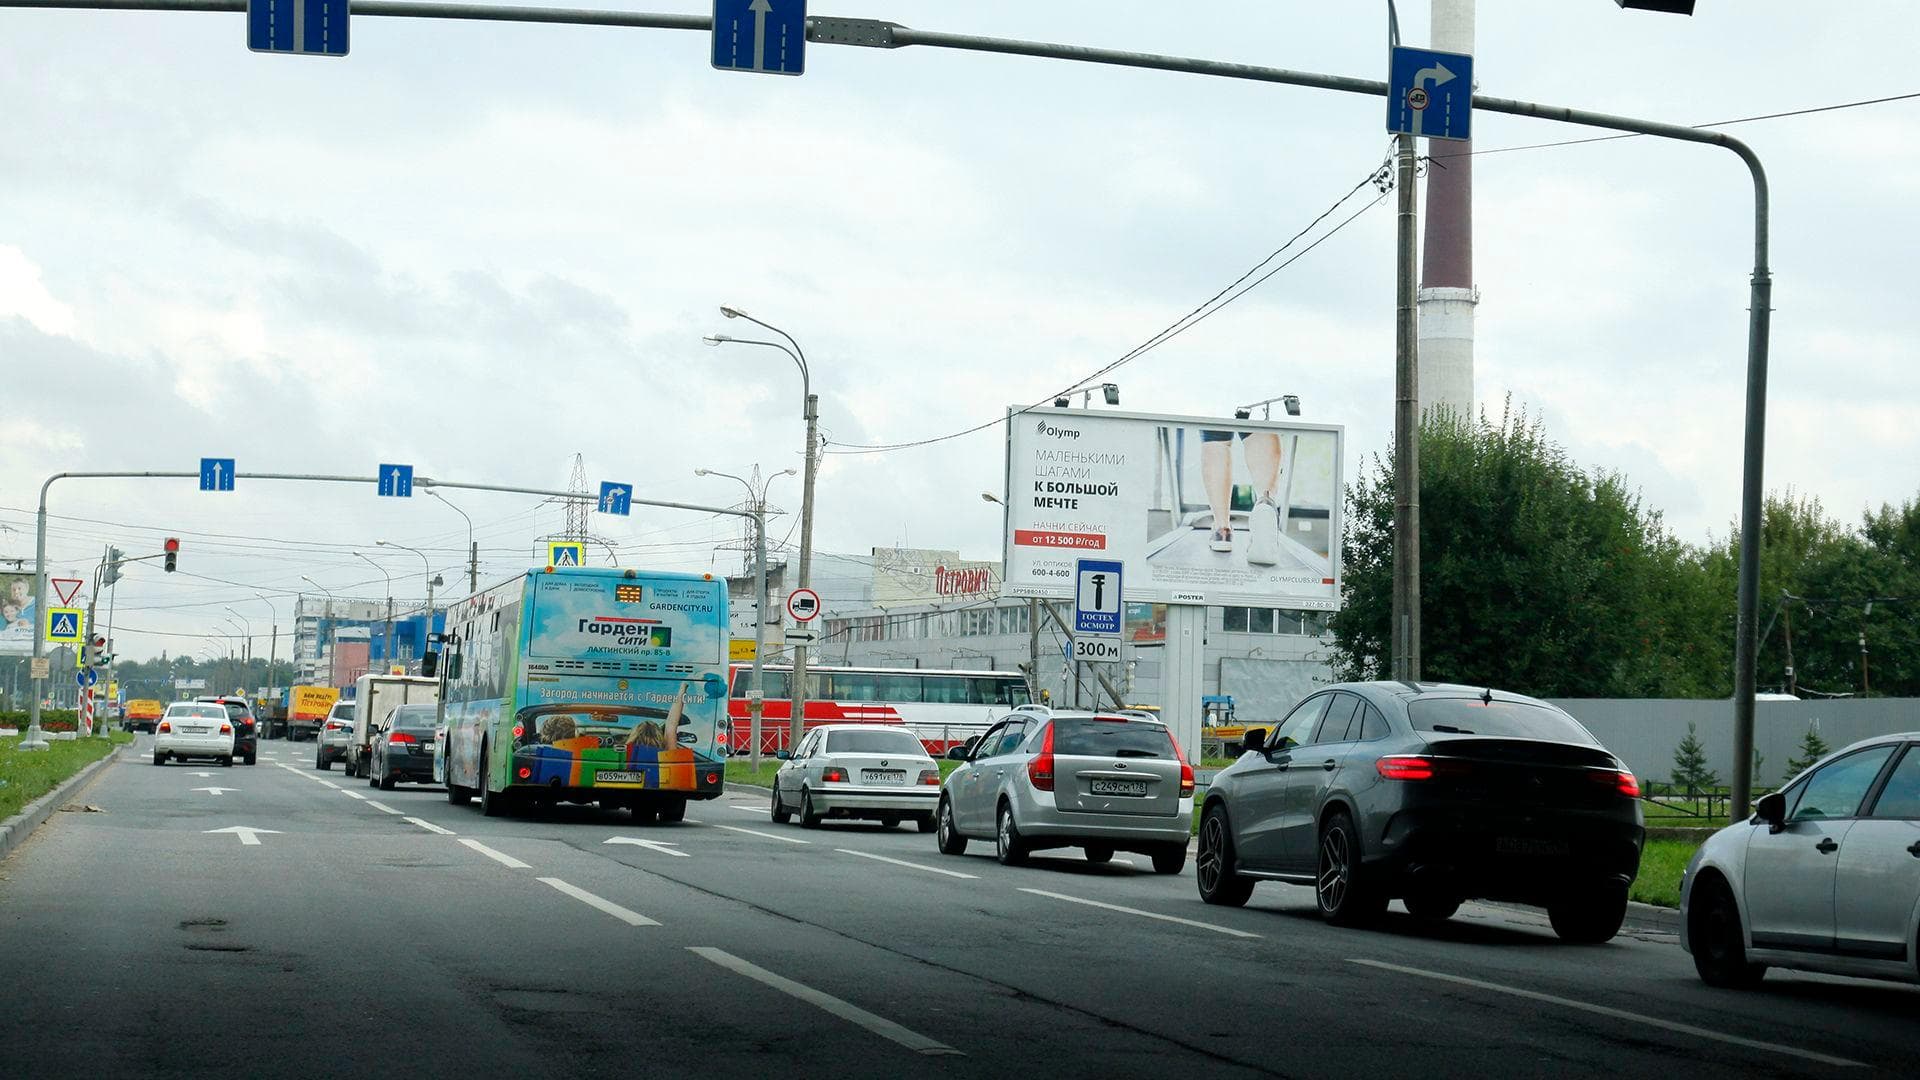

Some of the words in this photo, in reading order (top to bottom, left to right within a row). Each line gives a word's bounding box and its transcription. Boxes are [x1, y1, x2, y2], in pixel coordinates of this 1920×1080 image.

[1046, 427, 1080, 440] Olymp
[1035, 450, 1125, 465] МАЛЕНЬКИМИ
[1035, 465, 1090, 479] ШАГАМИ
[1034, 481, 1043, 492] К
[1047, 482, 1118, 496] БОЛЬШОЙ
[1033, 497, 1078, 510] МЕЧТЕ
[1033, 520, 1065, 530] НАЧНИ
[1067, 521, 1106, 533] СЕЙЧАС!
[1045, 536, 1055, 544] 12
[1058, 537, 1074, 545] 500
[1032, 568, 1070, 578] 600-4-600
[649, 602, 713, 613] GARDENCITY.RU
[1081, 612, 1114, 622] ГОСТЕХ
[578, 618, 648, 636] Гарден
[1080, 621, 1116, 630] ОСМОТР
[587, 646, 639, 655] ЛАХТИНСКИЙ
[1076, 641, 1106, 657] 300
[540, 688, 578, 701] Загород
[581, 690, 633, 702] начинается
[645, 692, 680, 705] Гарден
